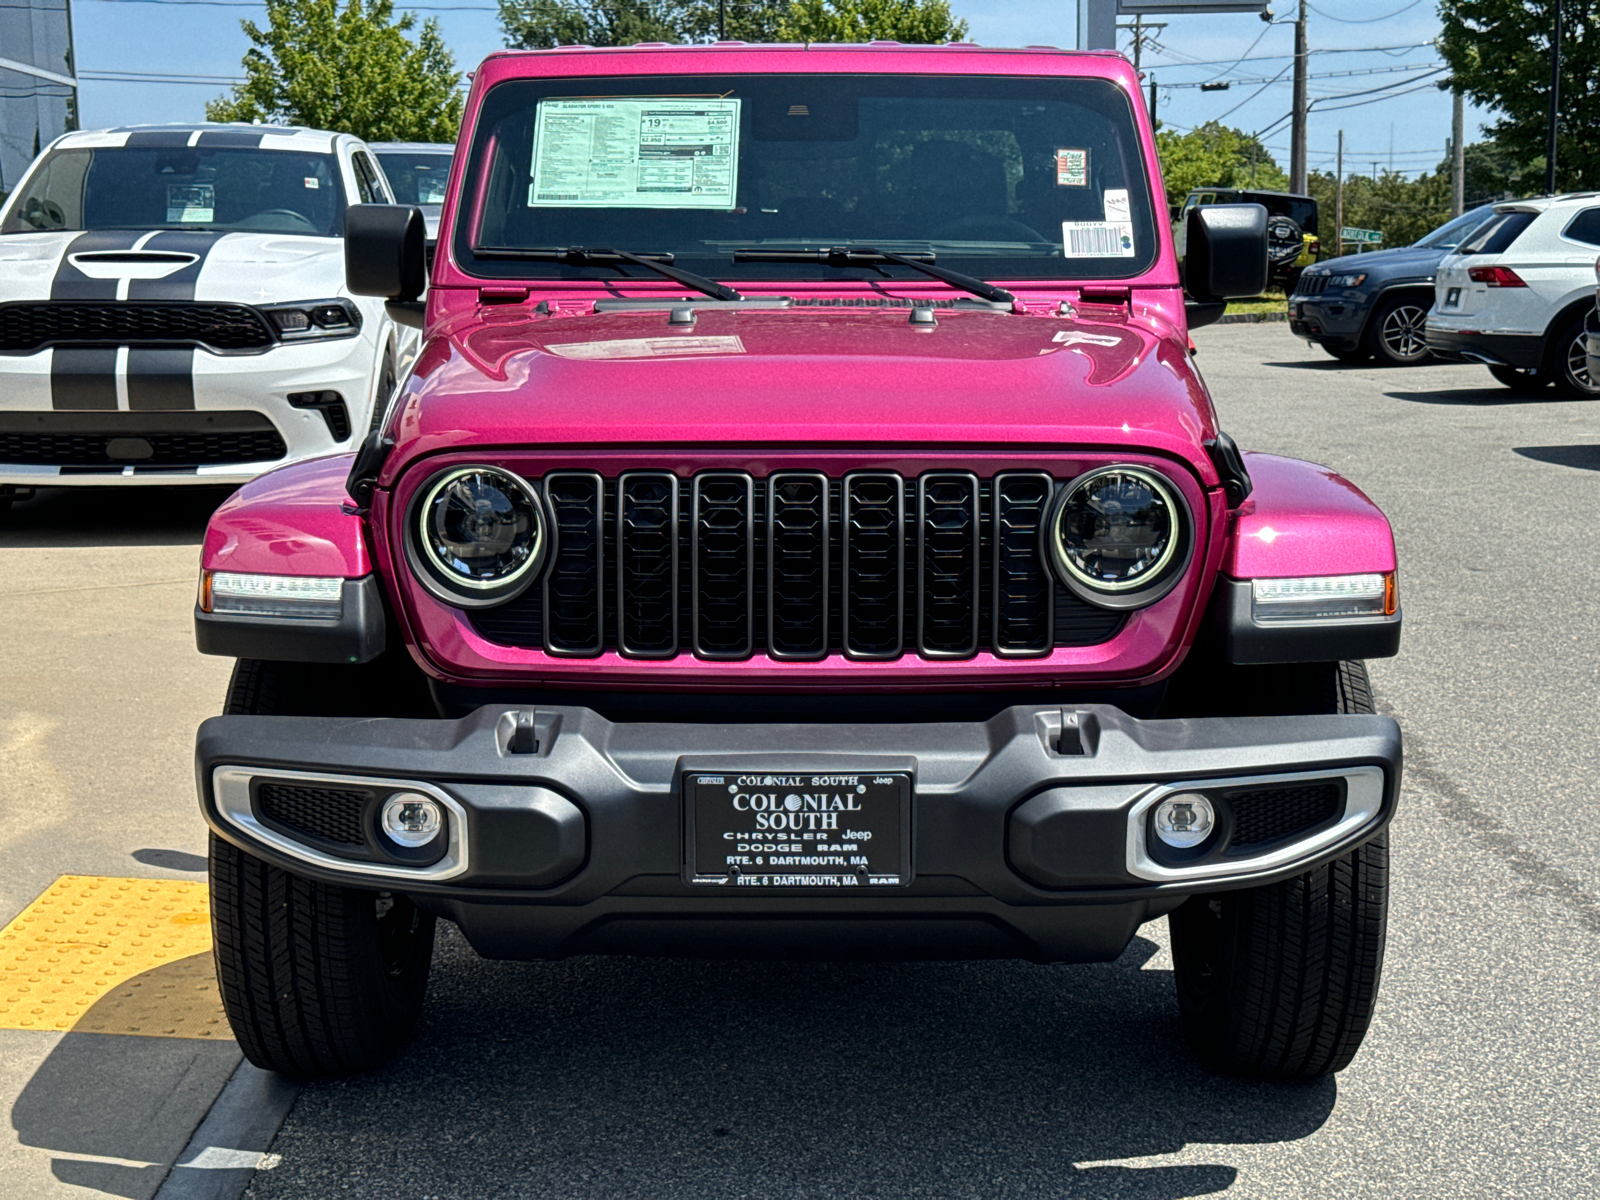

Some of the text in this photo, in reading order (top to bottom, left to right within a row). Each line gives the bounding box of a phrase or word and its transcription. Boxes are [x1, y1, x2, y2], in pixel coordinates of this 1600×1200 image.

[648, 119, 661, 127] 19
[1342, 229, 1368, 241] NORFOLK
[737, 776, 858, 786] COLONIAL SOUTH
[733, 794, 861, 811] COLONIAL
[756, 812, 838, 830] SOUTH
[842, 829, 872, 841] Jeep
[726, 856, 868, 866] RTE. 6 DARTMOUTH, MA
[737, 877, 858, 886] RTE. 6 DARTMOUTH, MA
